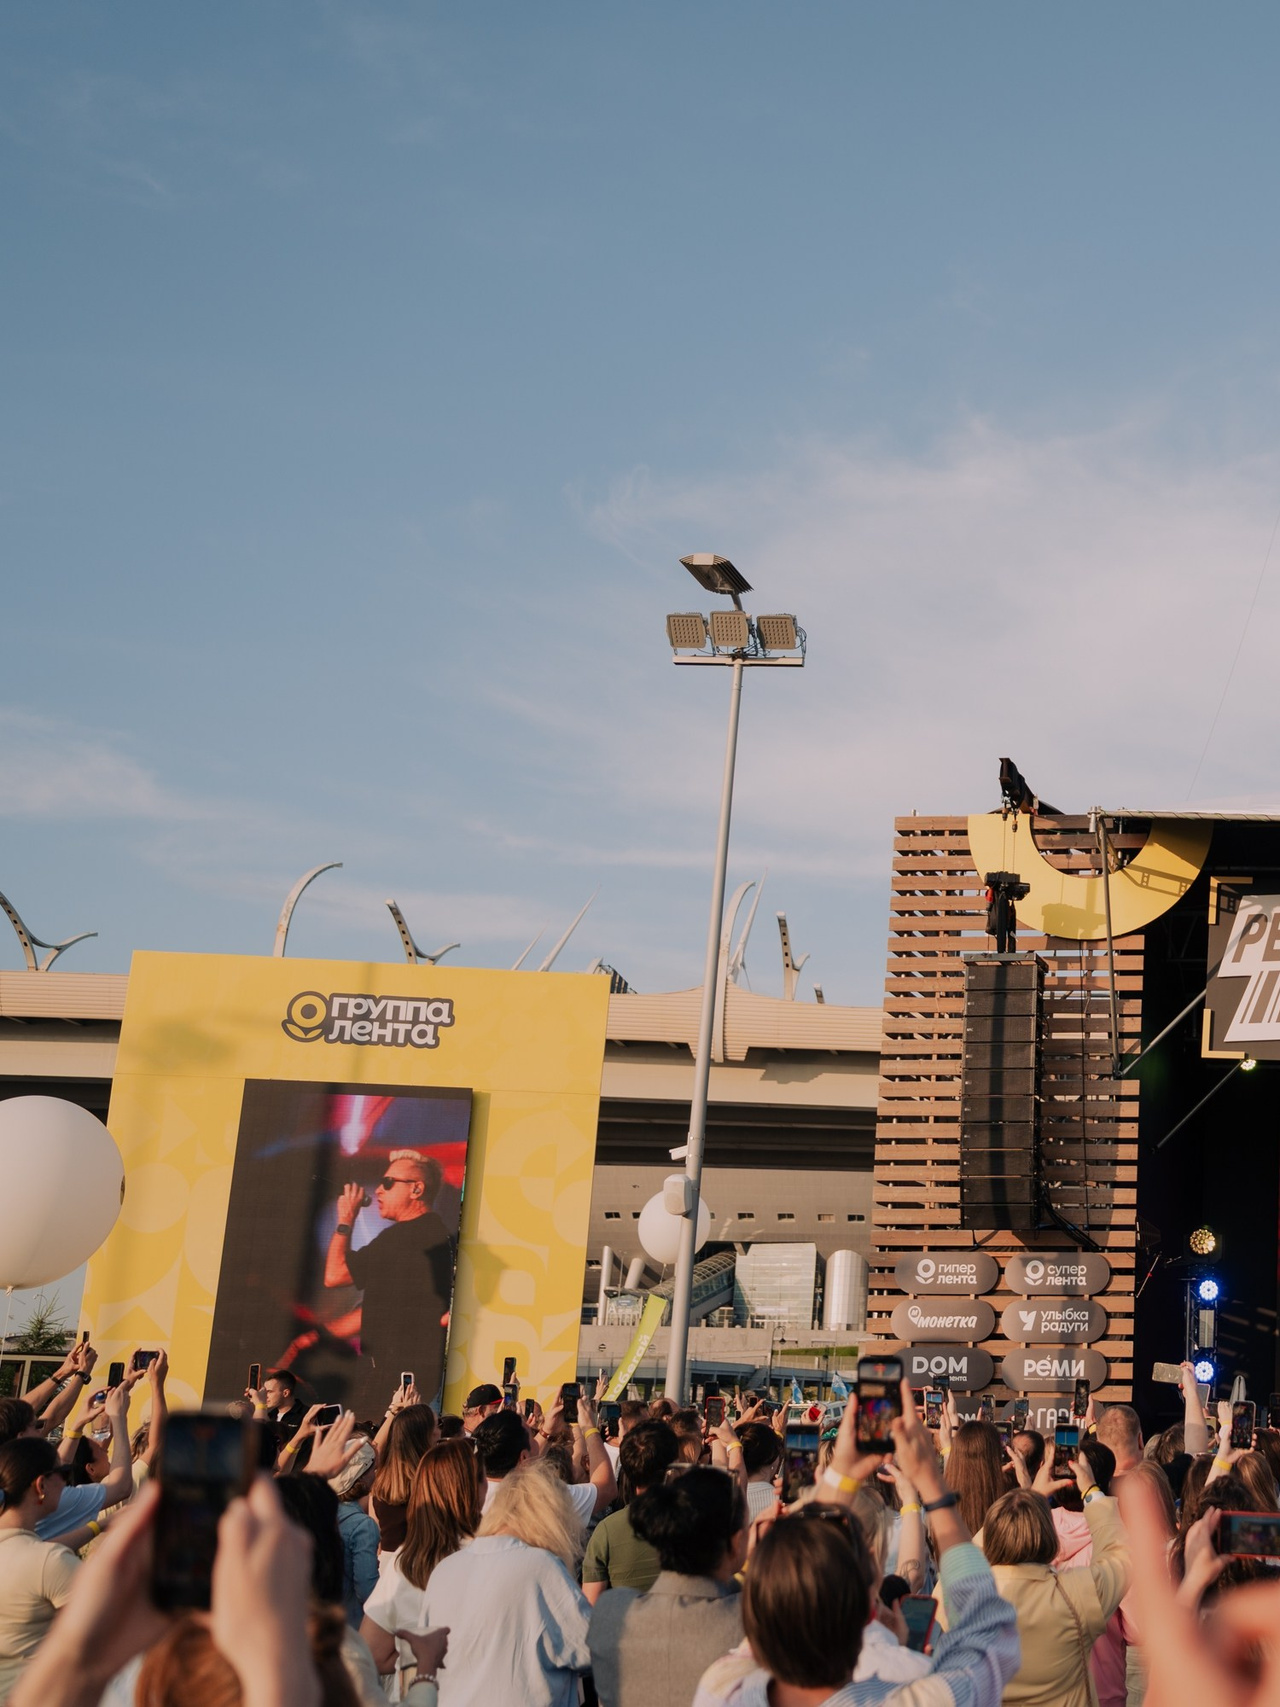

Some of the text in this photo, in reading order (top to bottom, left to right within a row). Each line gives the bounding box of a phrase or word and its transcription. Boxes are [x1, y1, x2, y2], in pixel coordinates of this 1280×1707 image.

[331, 996, 451, 1024] группа
[328, 1020, 436, 1046] лента
[939, 1264, 976, 1275] гипер
[1047, 1265, 1087, 1276] супер
[937, 1275, 977, 1284] лента
[1046, 1276, 1087, 1286] лента
[1041, 1308, 1088, 1321] улыбка
[918, 1316, 978, 1328] монетка
[1041, 1322, 1088, 1333] радуги
